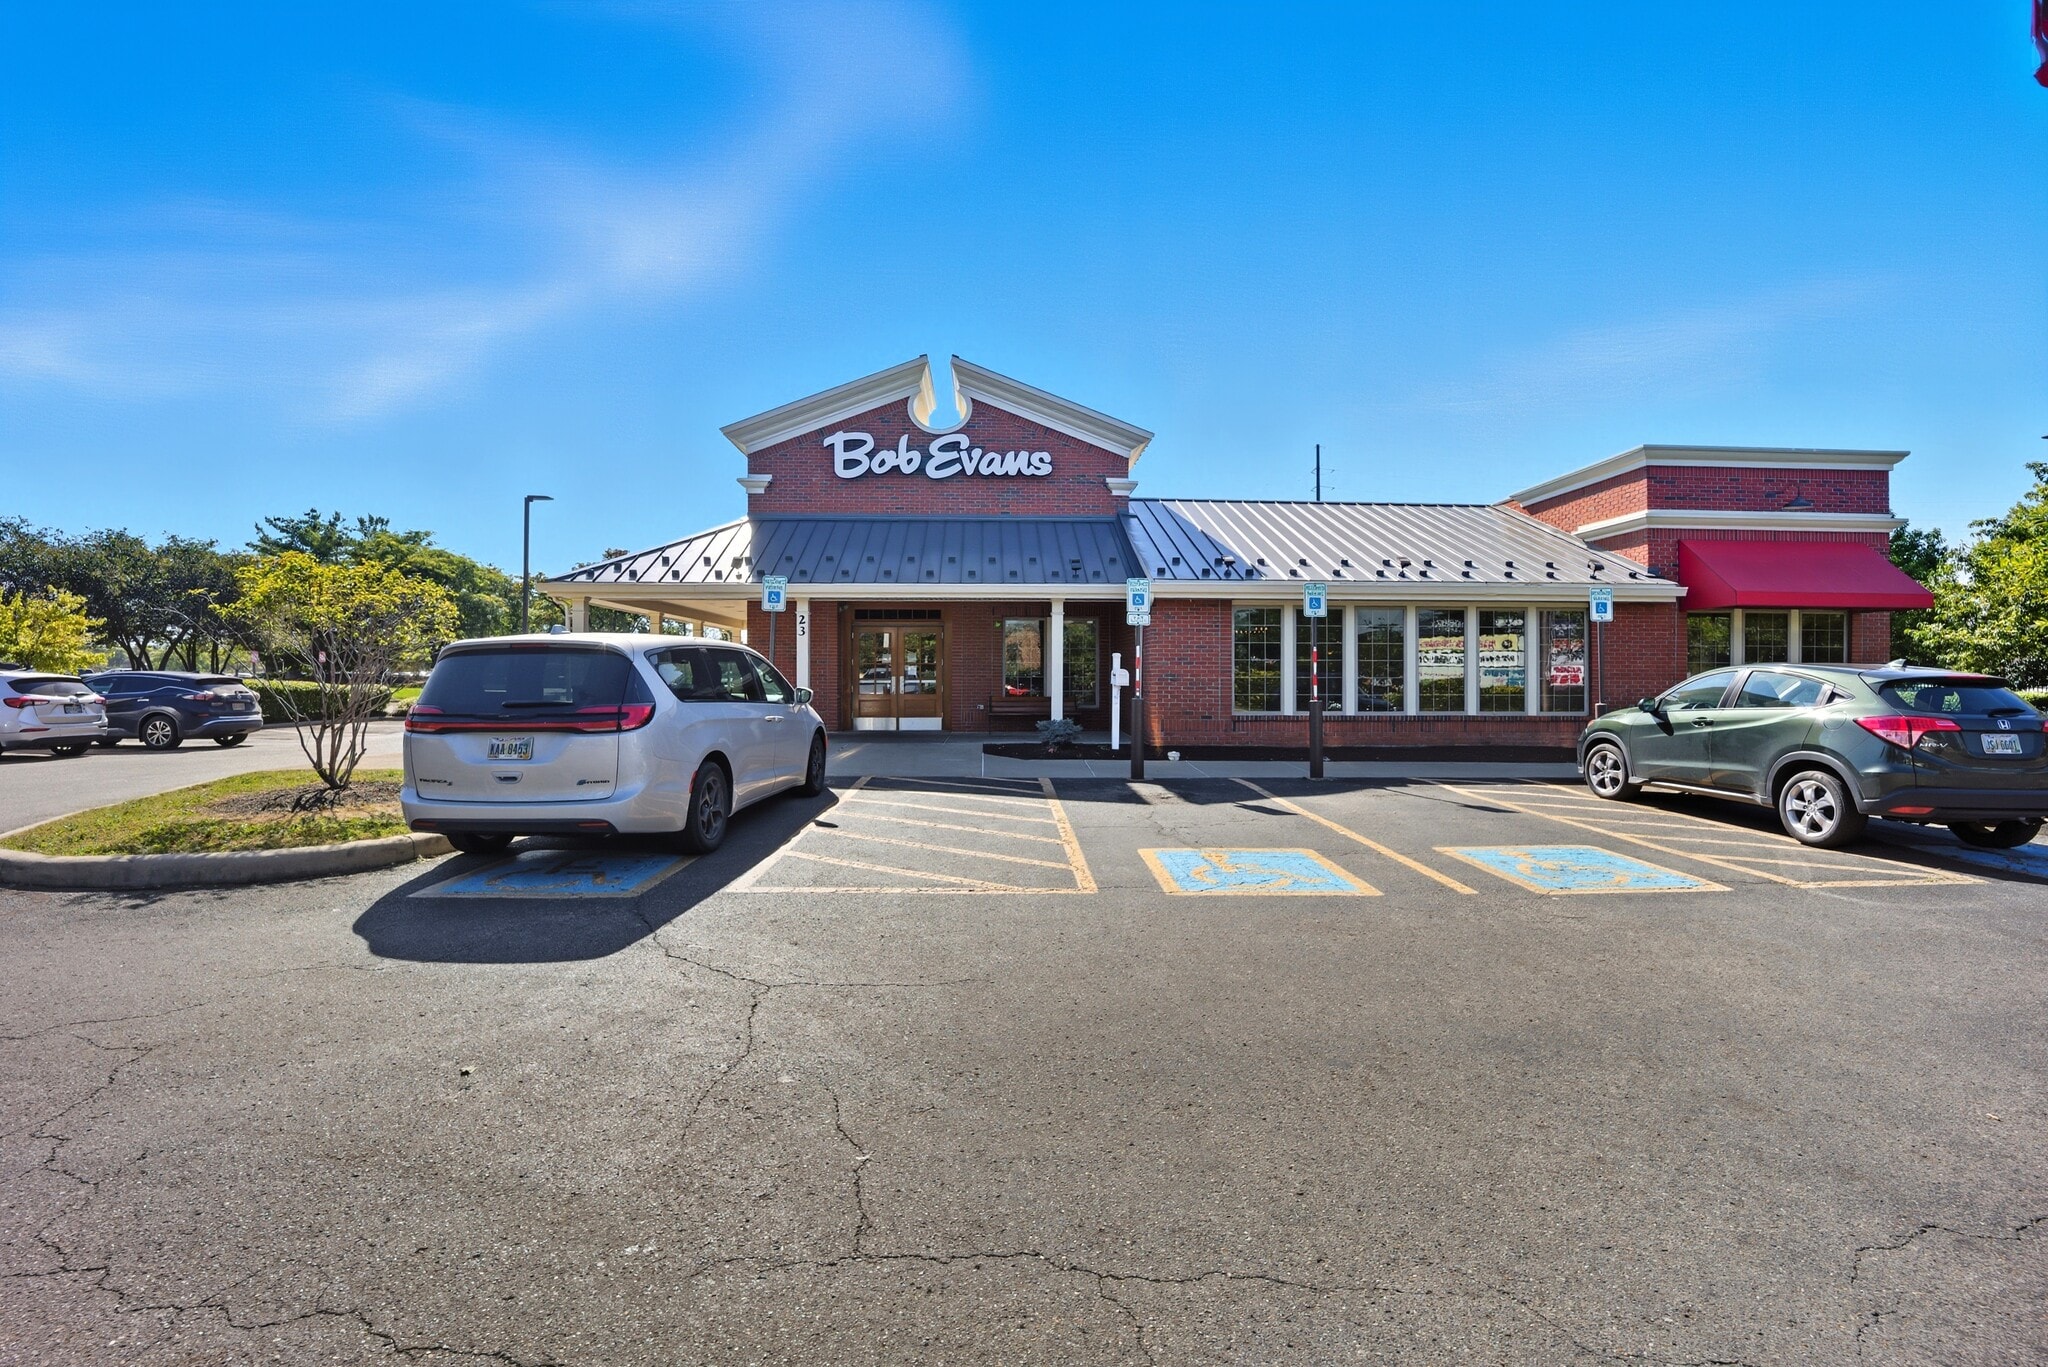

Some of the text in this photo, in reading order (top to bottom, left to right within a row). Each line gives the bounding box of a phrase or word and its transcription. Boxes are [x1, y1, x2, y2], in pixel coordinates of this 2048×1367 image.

[823, 431, 1053, 479] Bob Evans
[507, 743, 529, 755] 8453
